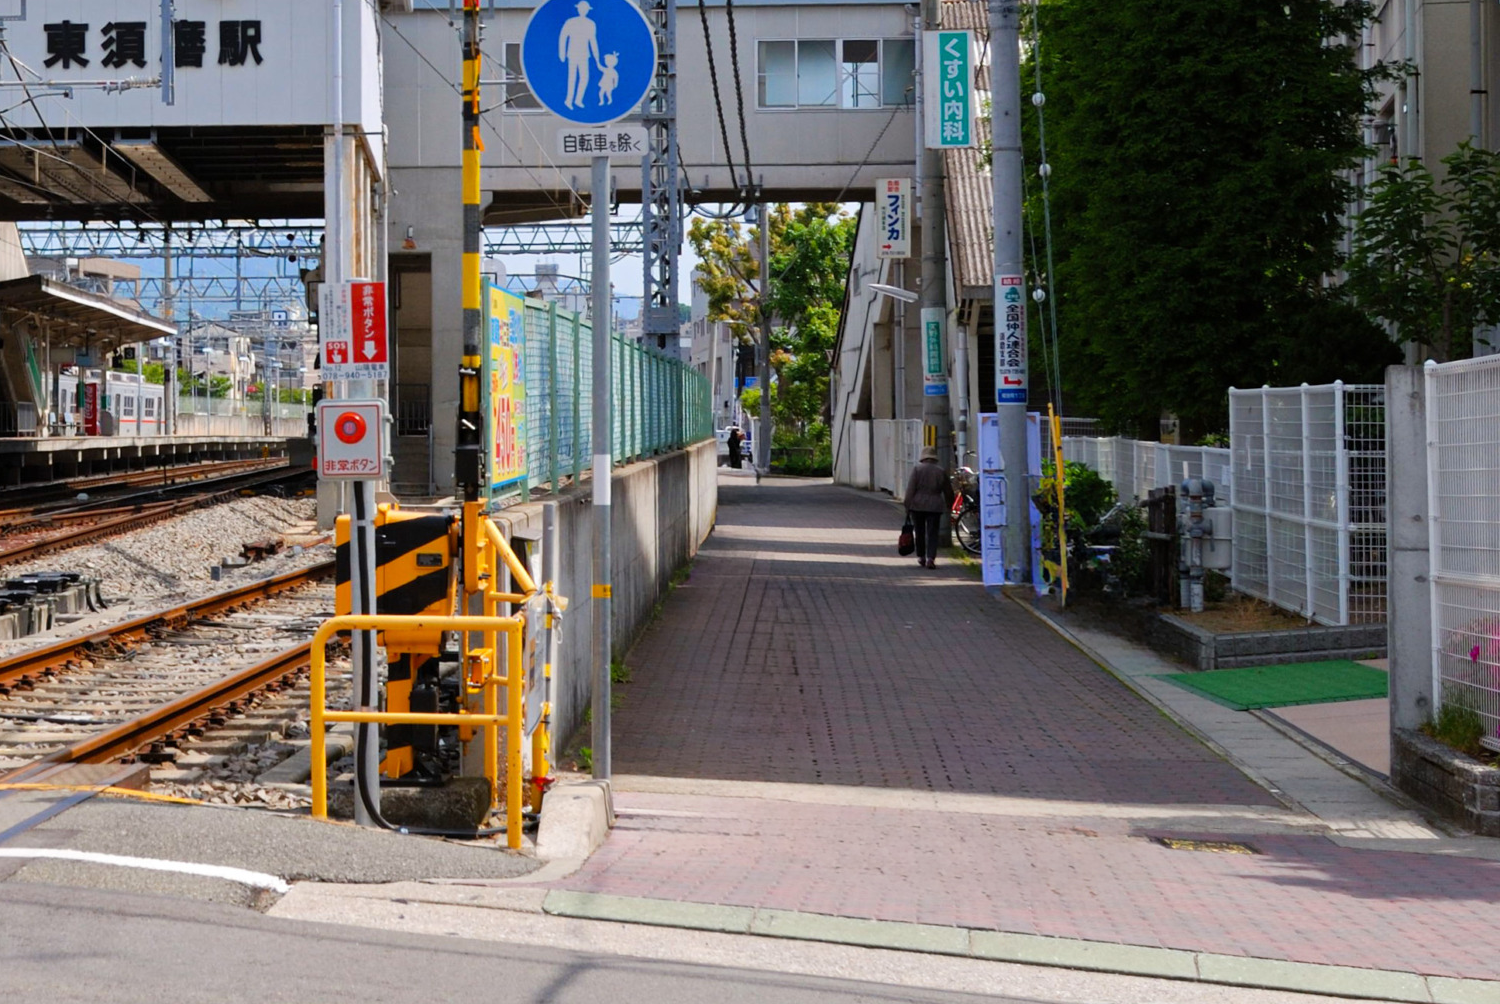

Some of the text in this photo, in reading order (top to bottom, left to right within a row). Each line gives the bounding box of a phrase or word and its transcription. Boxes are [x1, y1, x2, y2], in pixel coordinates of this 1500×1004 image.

[43, 19, 263, 69] 東須磨駅
[943, 38, 964, 142] くすい内科
[563, 132, 642, 153] 自転車を除く
[887, 194, 900, 241] フィンカ
[362, 284, 375, 339] 非常ボタン
[1006, 303, 1020, 368] 全国仲人連合会
[322, 371, 388, 380] 078-940-5187
[325, 458, 378, 471] 非常ボタン
